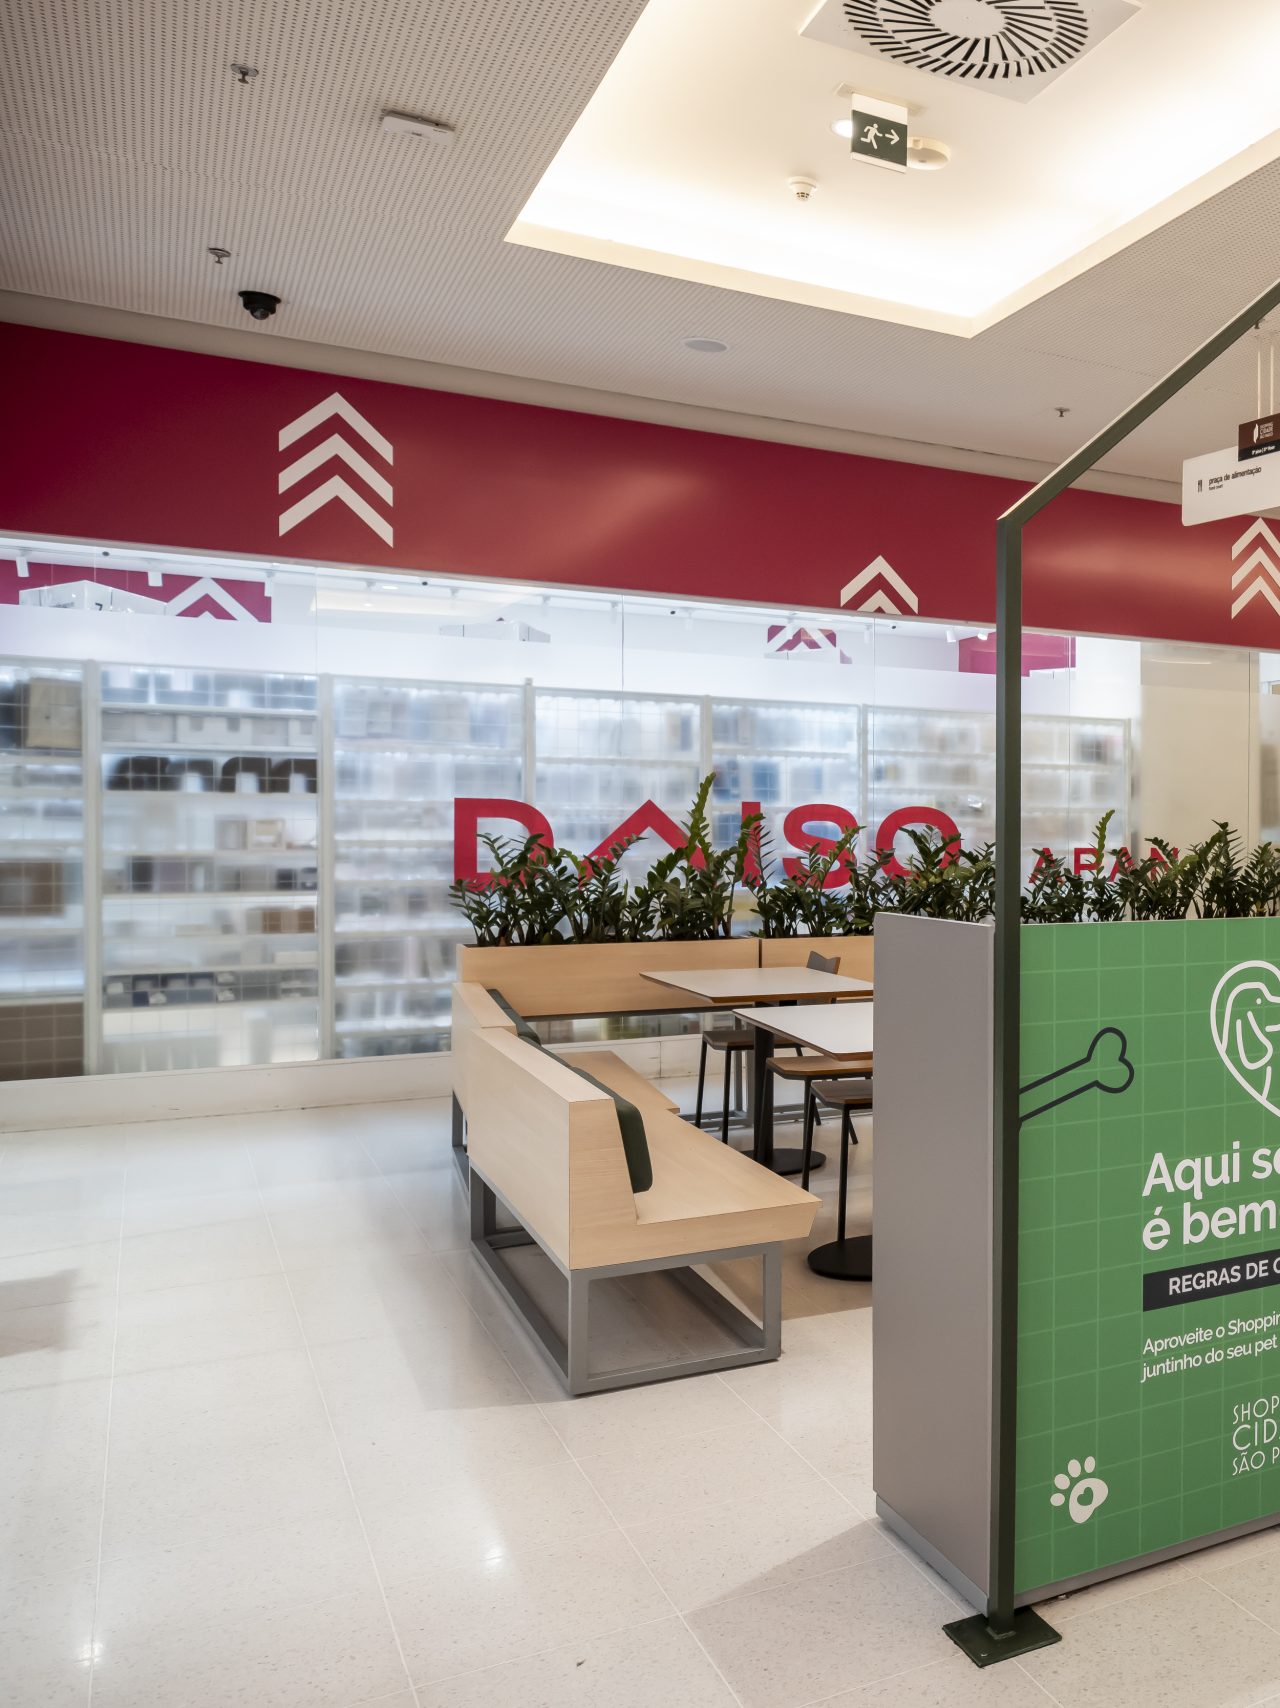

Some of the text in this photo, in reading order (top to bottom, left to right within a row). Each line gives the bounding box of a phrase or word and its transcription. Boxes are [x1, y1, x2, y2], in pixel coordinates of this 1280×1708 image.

[1208, 477, 1223, 486] praça
[1231, 466, 1262, 480] alimentação
[454, 797, 962, 890] DAISO
[1028, 847, 1180, 884] APAN
[1142, 1141, 1240, 1200] Aqui
[1142, 1206, 1171, 1250] é
[1168, 1265, 1241, 1295] REGRAS
[1246, 1260, 1269, 1280] DE
[1141, 1354, 1202, 1383] juntinho
[1205, 1348, 1224, 1364] do
[1227, 1343, 1251, 1359] seu
[1255, 1334, 1277, 1356] pet
[1143, 1328, 1213, 1356] Aproveite
[1216, 1327, 1225, 1338] o
[1232, 1453, 1265, 1476] SÃO
